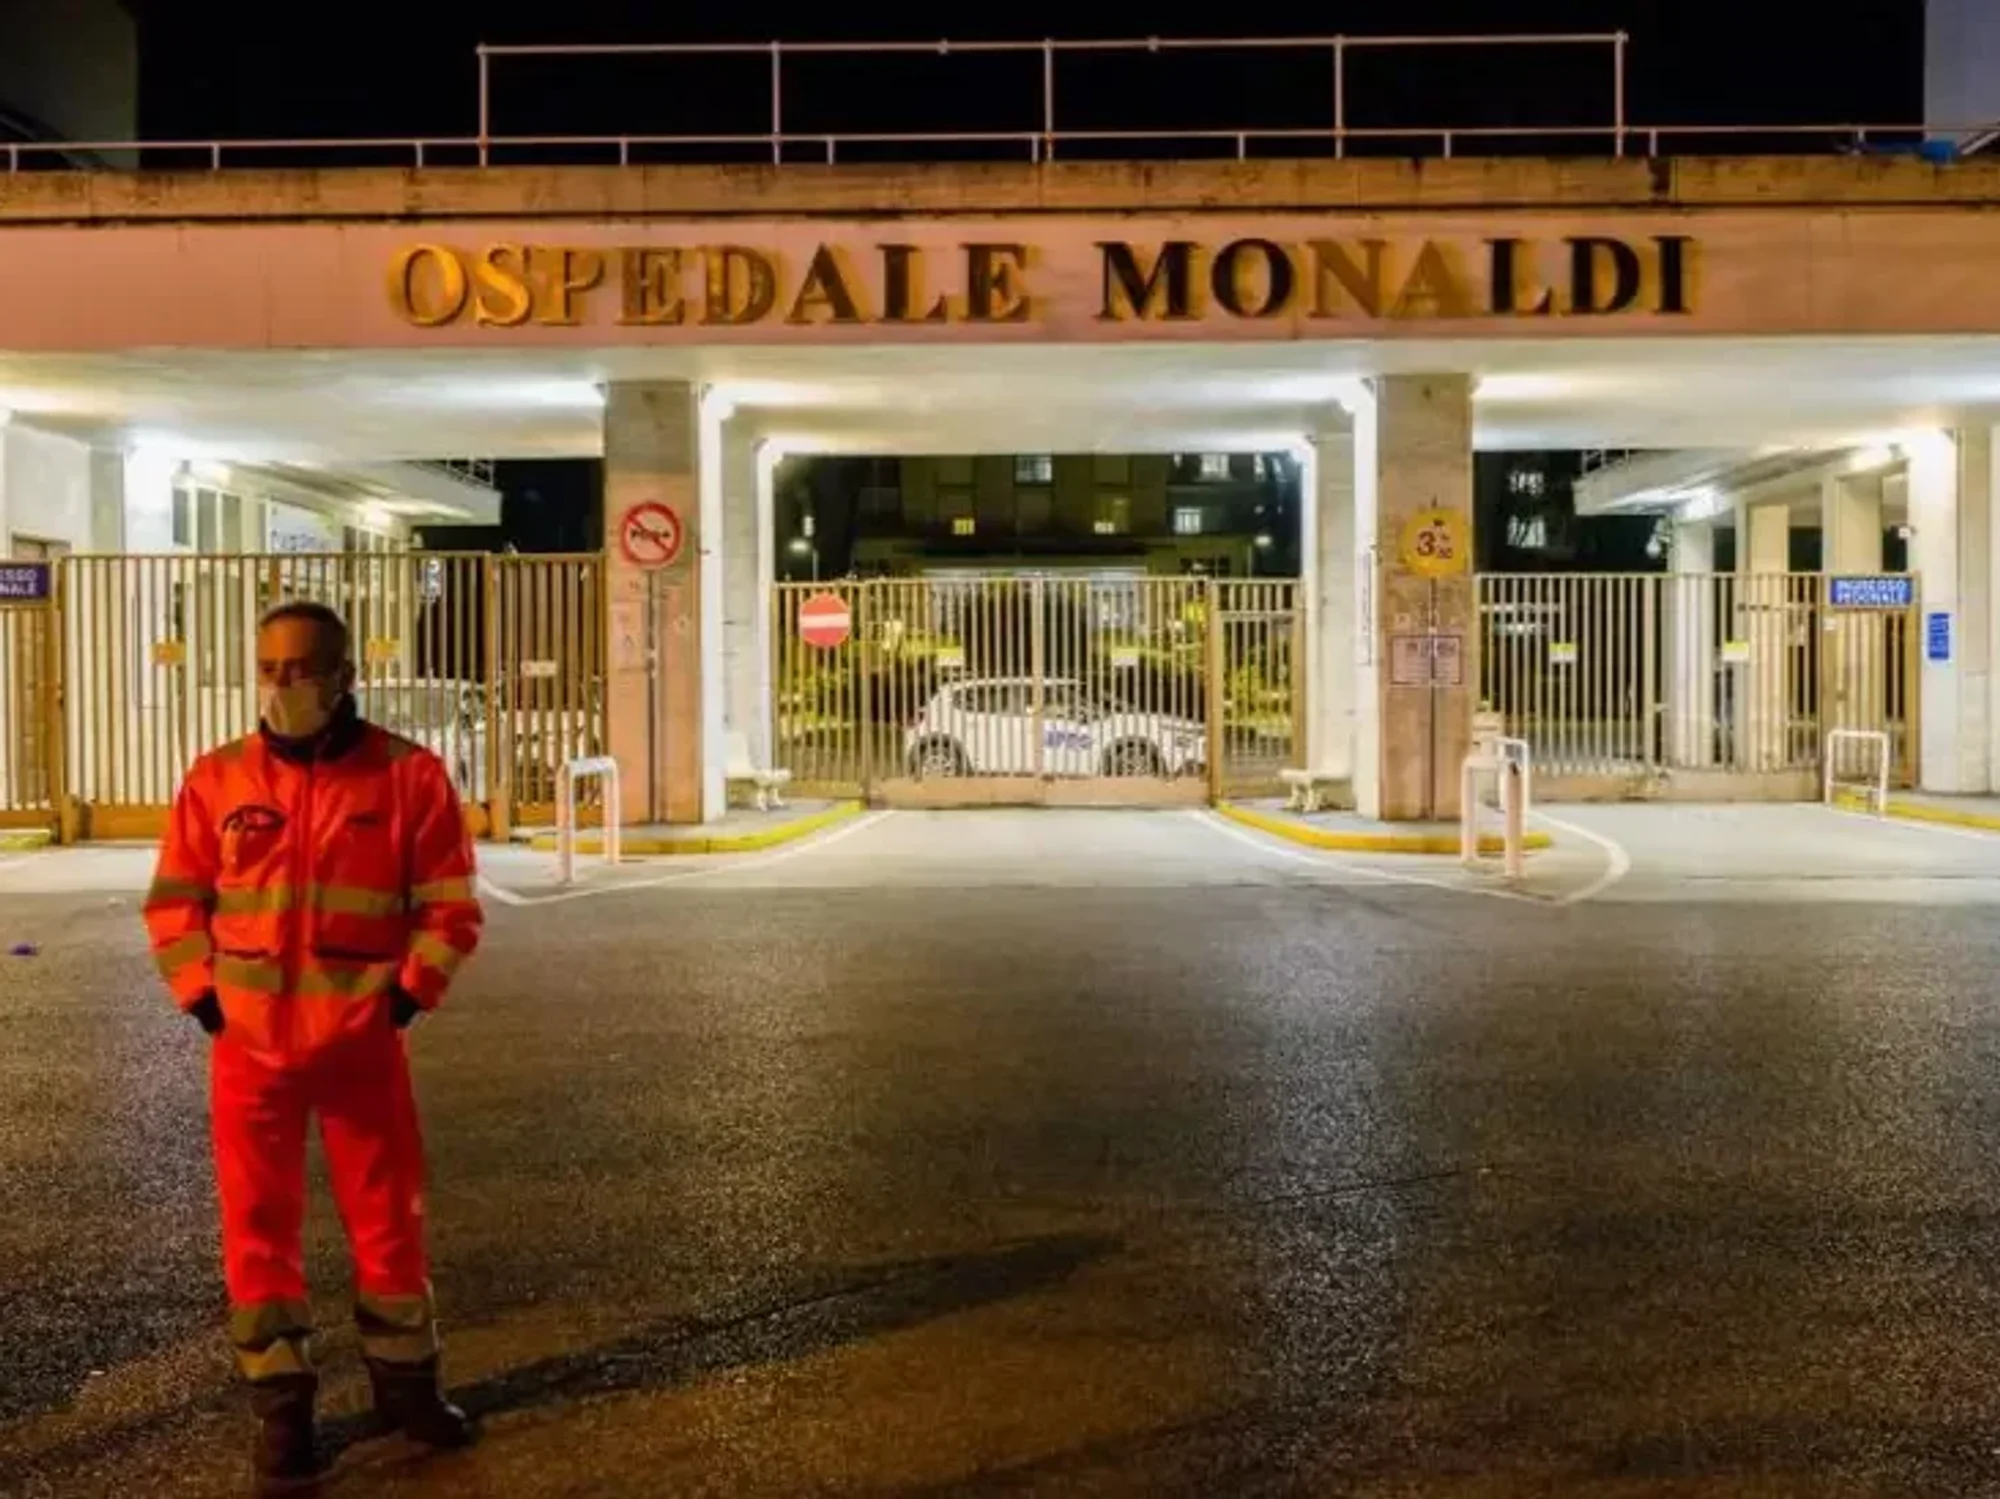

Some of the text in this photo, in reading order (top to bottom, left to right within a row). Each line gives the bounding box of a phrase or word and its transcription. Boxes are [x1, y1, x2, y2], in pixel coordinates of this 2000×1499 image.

[395, 235, 1694, 328] OSPEDALE MONALDI
[1416, 530, 1436, 557] 3
